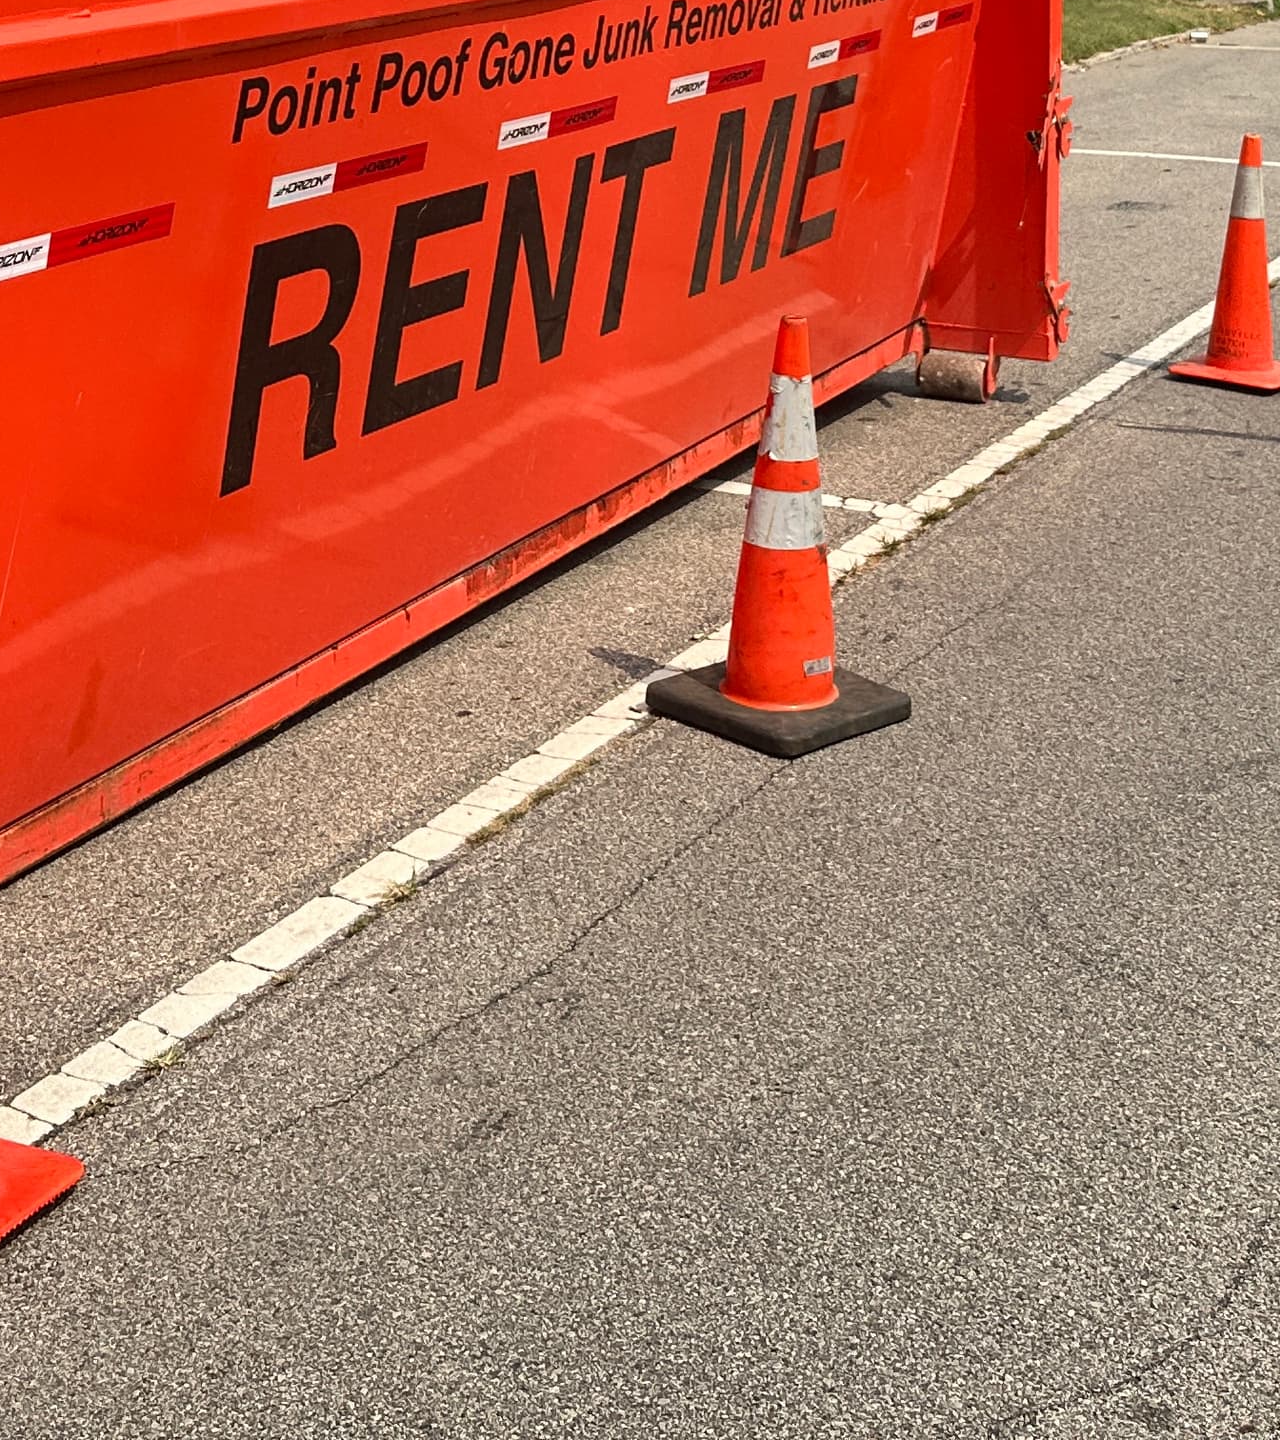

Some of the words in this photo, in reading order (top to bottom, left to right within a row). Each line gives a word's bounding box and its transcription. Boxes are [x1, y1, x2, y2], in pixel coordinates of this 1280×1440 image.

[232, 62, 363, 144] Point
[368, 37, 473, 114] Poof
[478, 32, 577, 89] Gone
[582, 6, 659, 70] Junk
[220, 128, 675, 498] RENT
[688, 72, 859, 299] ME
